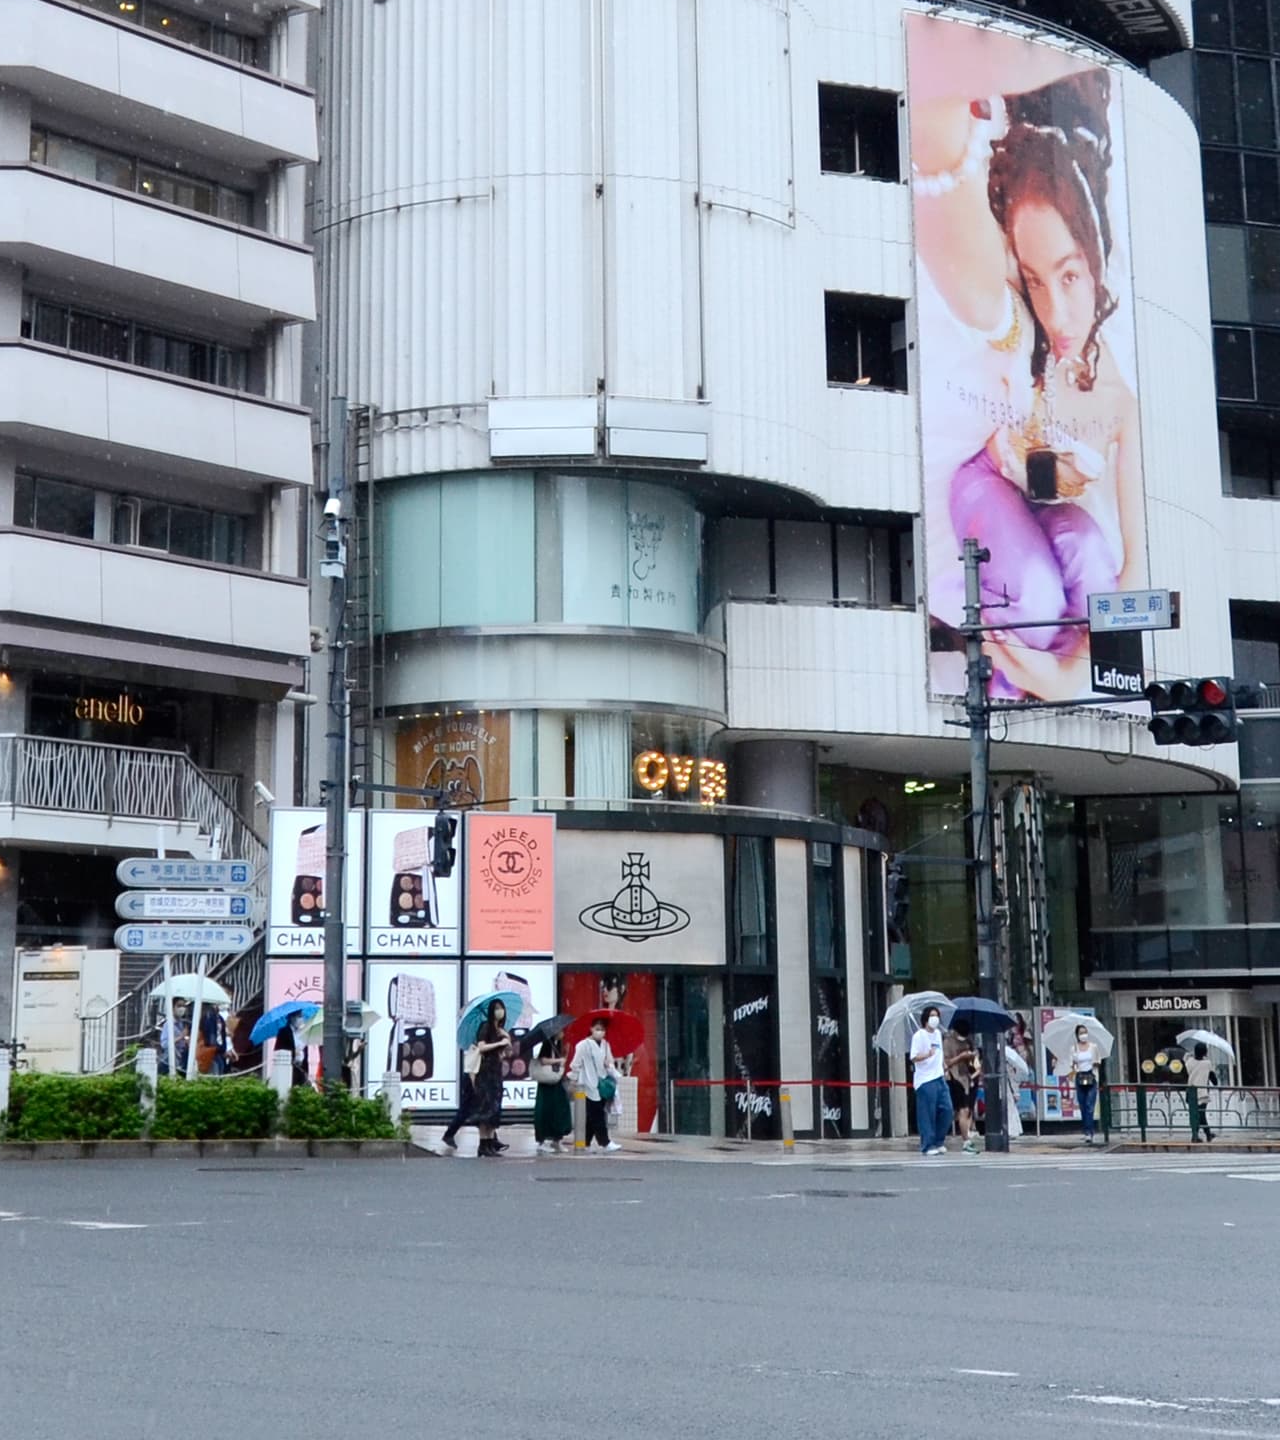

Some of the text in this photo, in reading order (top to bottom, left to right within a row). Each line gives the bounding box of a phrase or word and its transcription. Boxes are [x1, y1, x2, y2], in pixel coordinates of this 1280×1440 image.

[1096, 595, 1163, 615] 神宮前
[1093, 664, 1143, 693] Laforet
[74, 692, 143, 726] anello
[413, 721, 497, 754] MAKE YOURSELF
[449, 740, 477, 753] HOME
[483, 827, 538, 851] TWEED
[480, 867, 543, 898] PARTNERS
[277, 933, 353, 948] CHAN
[376, 933, 452, 948] CHANEL
[284, 976, 322, 998] TWE
[1143, 996, 1202, 1010] Justin Davis
[503, 1086, 537, 1101] ANE
